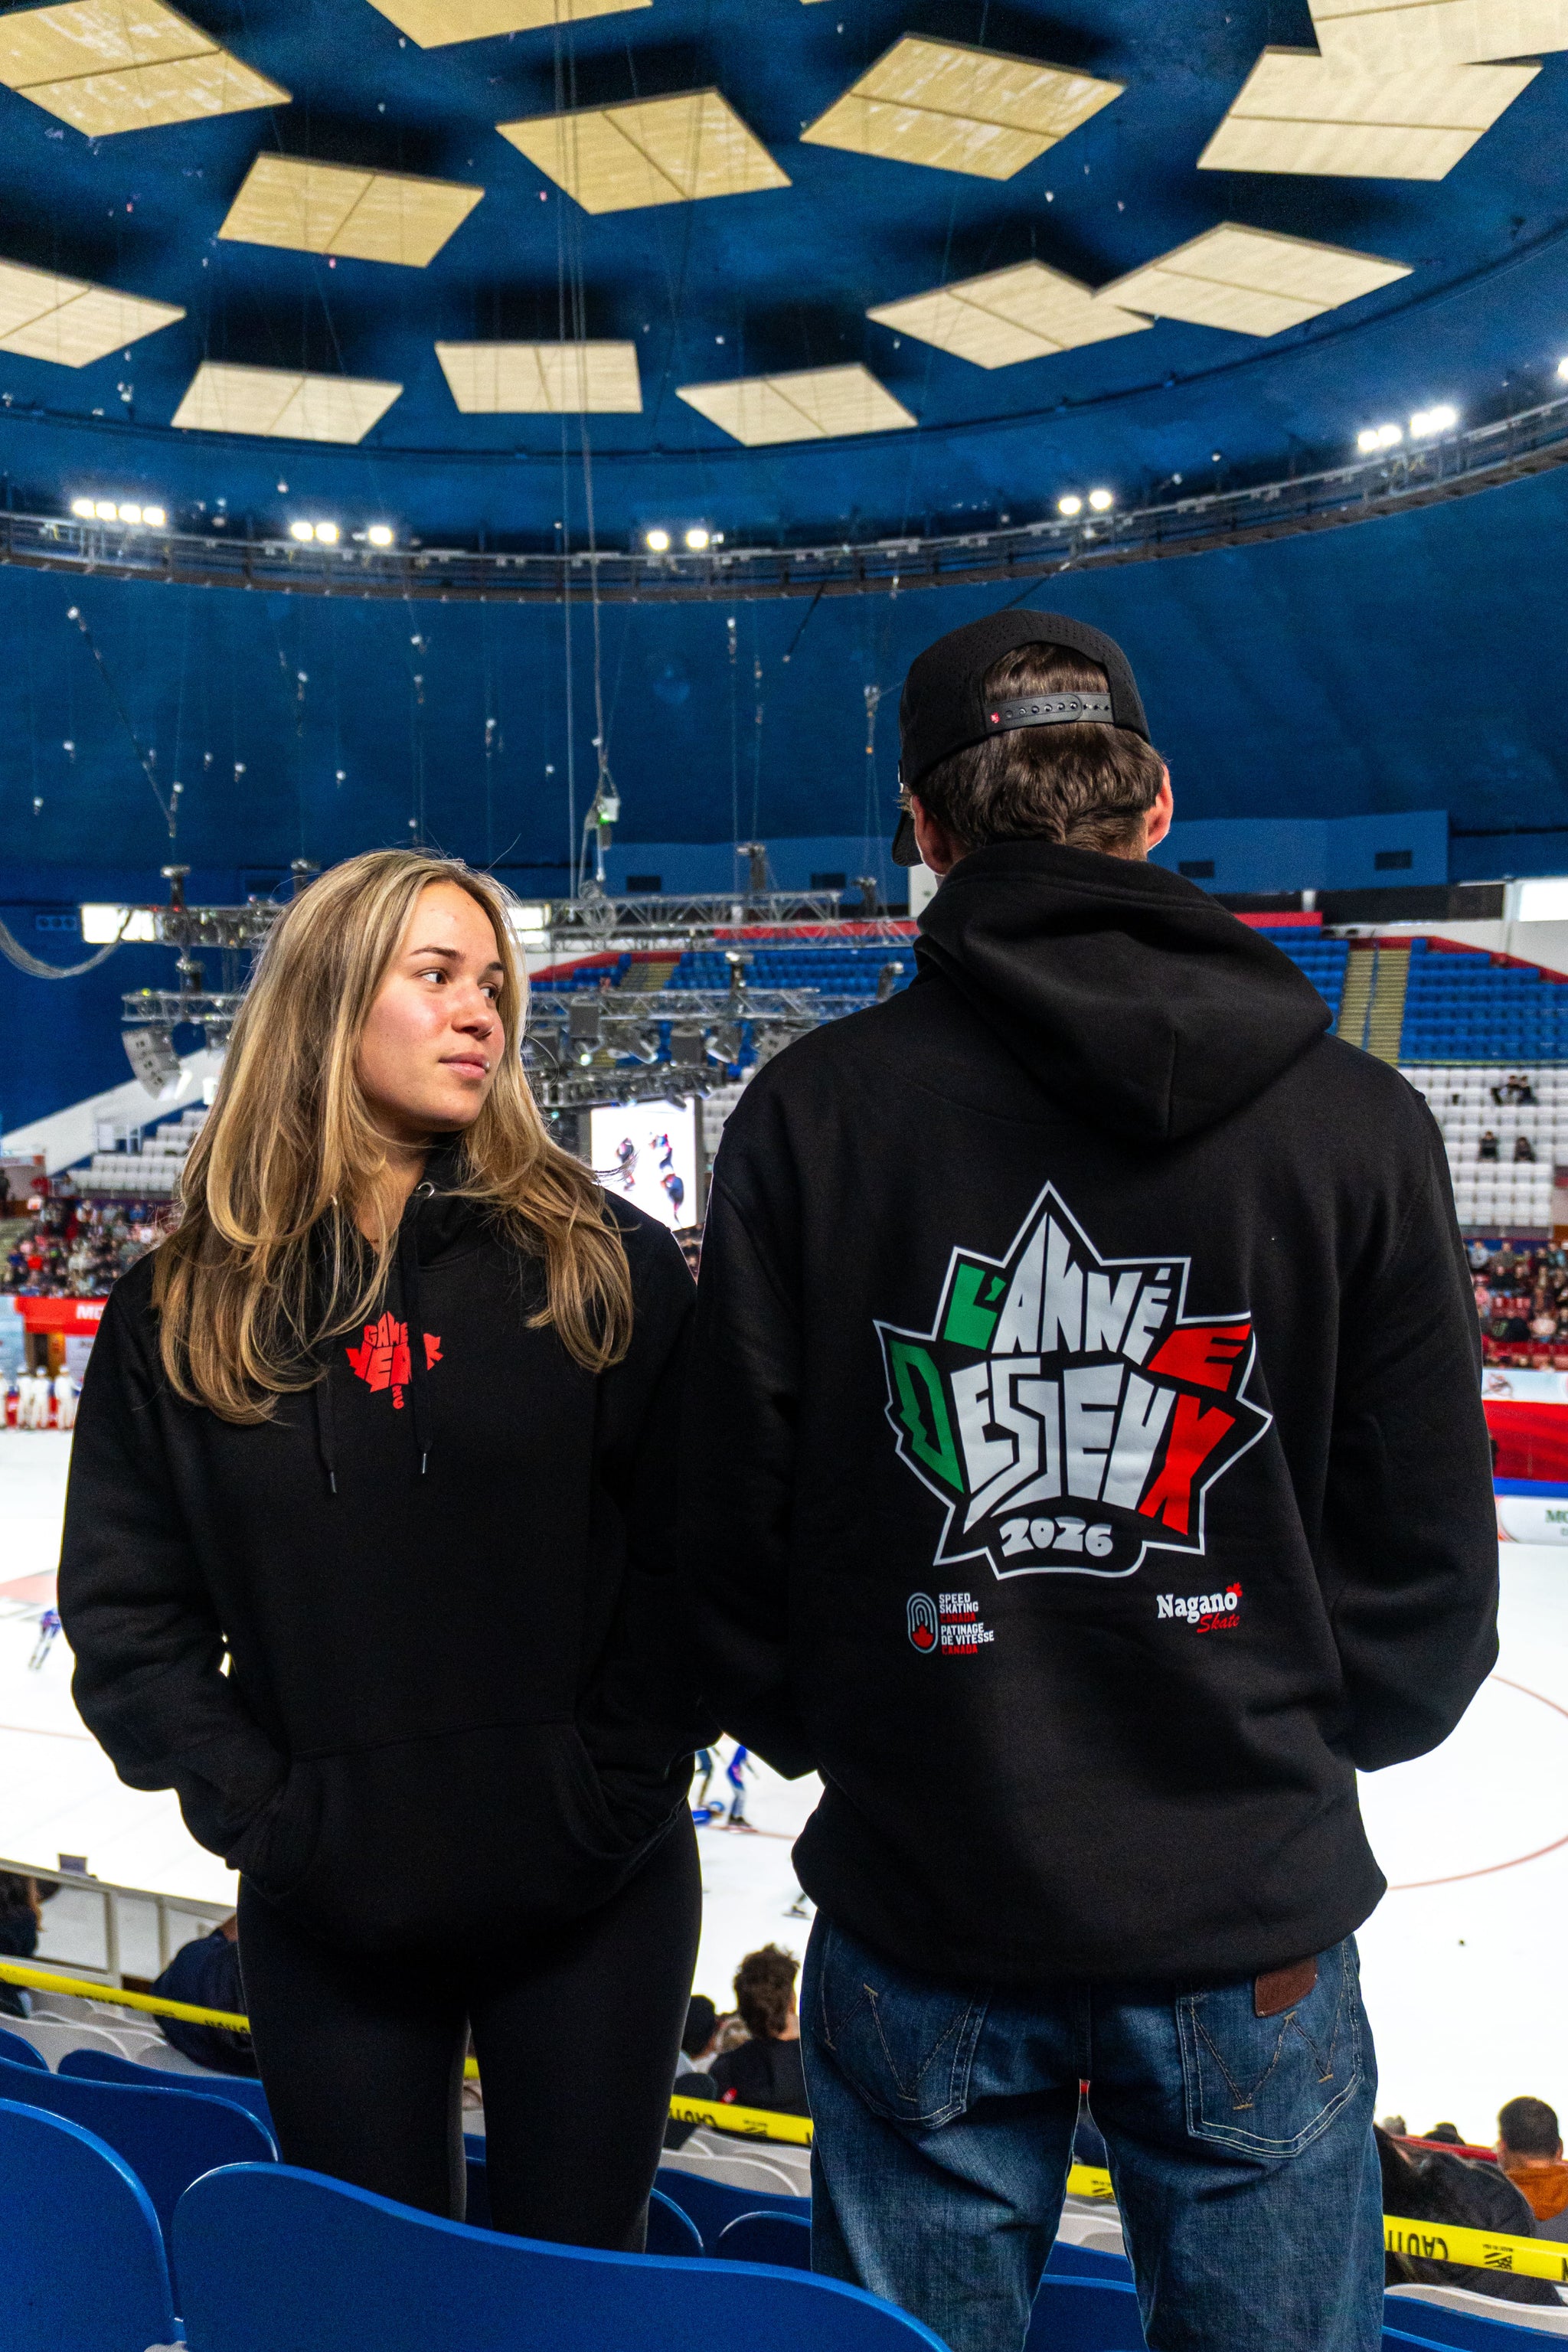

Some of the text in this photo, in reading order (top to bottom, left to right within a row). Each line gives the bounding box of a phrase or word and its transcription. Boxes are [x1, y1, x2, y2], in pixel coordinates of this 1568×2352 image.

[999, 1516, 1114, 1557] 2026
[939, 1593, 971, 1604] SPEED
[939, 1601, 979, 1614] SKATING
[1156, 1592, 1238, 1624] Nagano
[939, 1612, 976, 1623] CANADA
[1196, 1612, 1240, 1633] Skate
[941, 1622, 985, 1636] PATINAGE
[941, 1630, 995, 1646] DE VITESSE
[942, 1644, 978, 1655] CANADA
[1384, 2230, 1449, 2259] CAUTI
